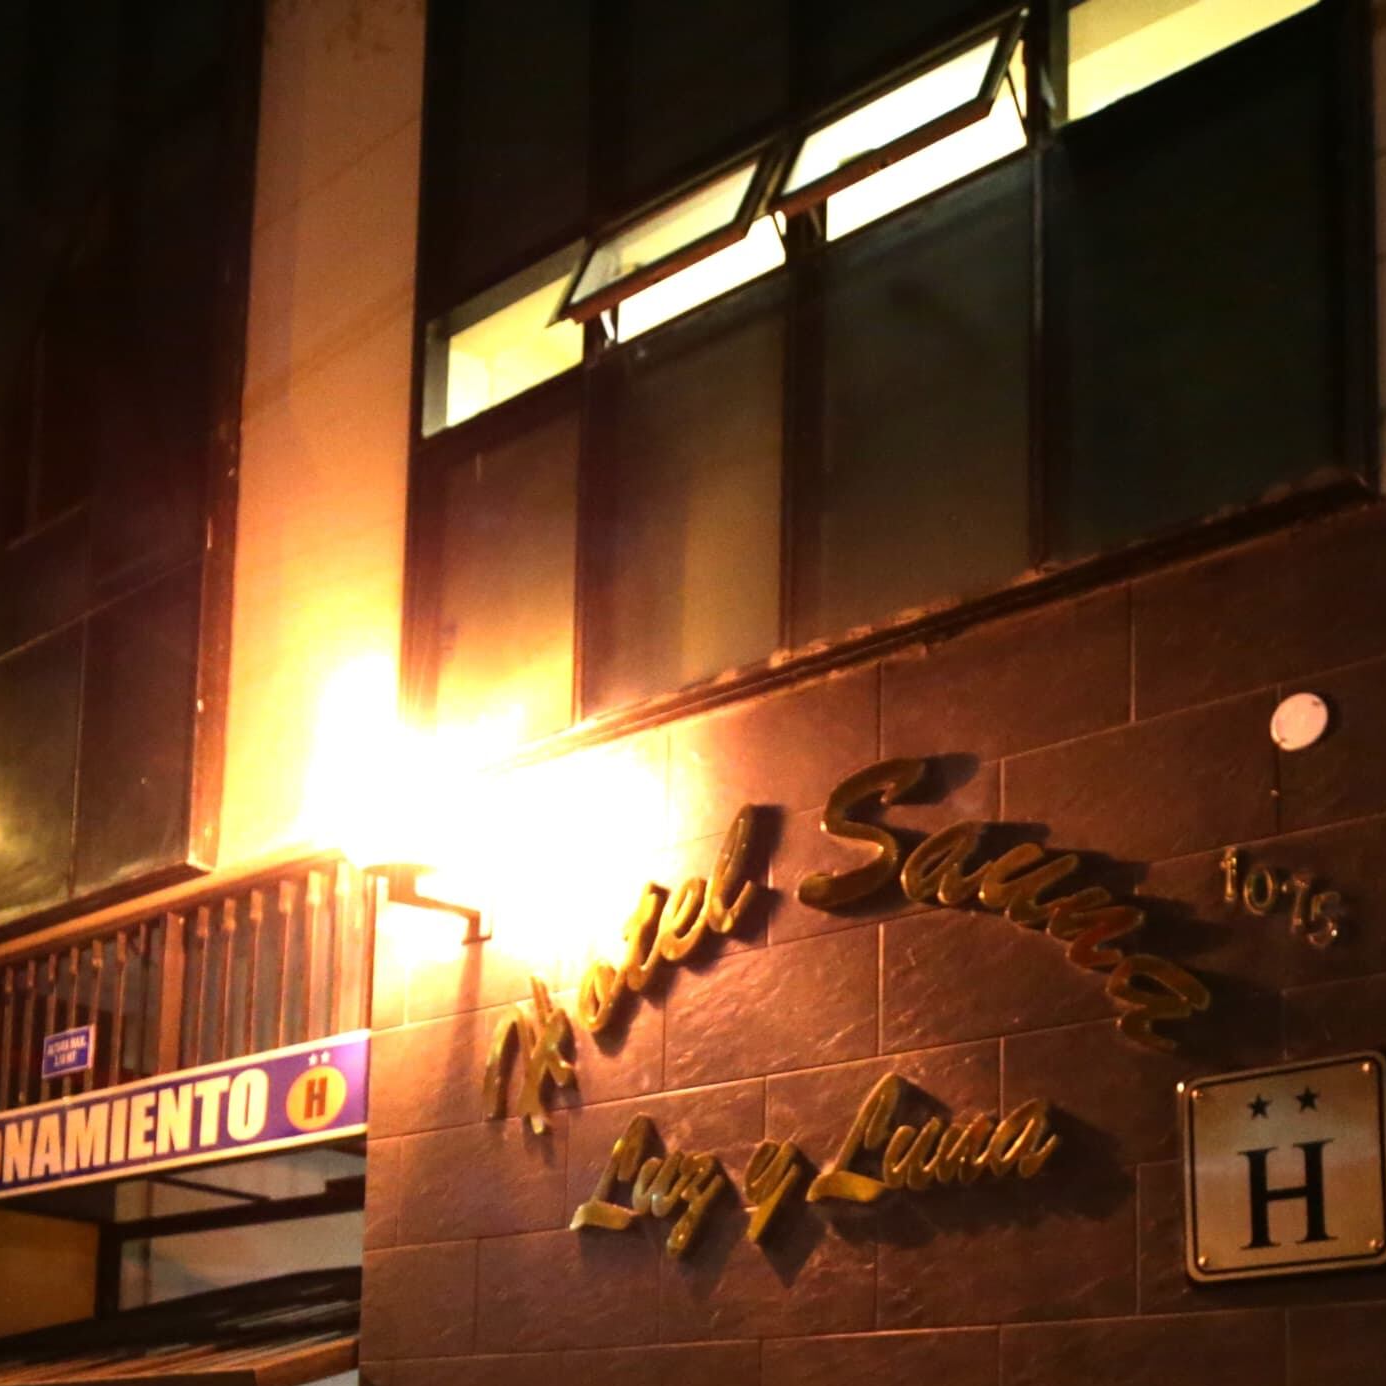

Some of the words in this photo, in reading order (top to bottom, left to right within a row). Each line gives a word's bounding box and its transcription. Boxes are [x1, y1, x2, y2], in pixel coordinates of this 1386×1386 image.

[483, 803, 753, 1135] Hotel
[796, 757, 1210, 1054] Sauna
[303, 1076, 328, 1120] H
[570, 1112, 723, 1257] Luz
[744, 1139, 798, 1243] y
[807, 1072, 1059, 1202] Luna
[1237, 1137, 1338, 1250] H
